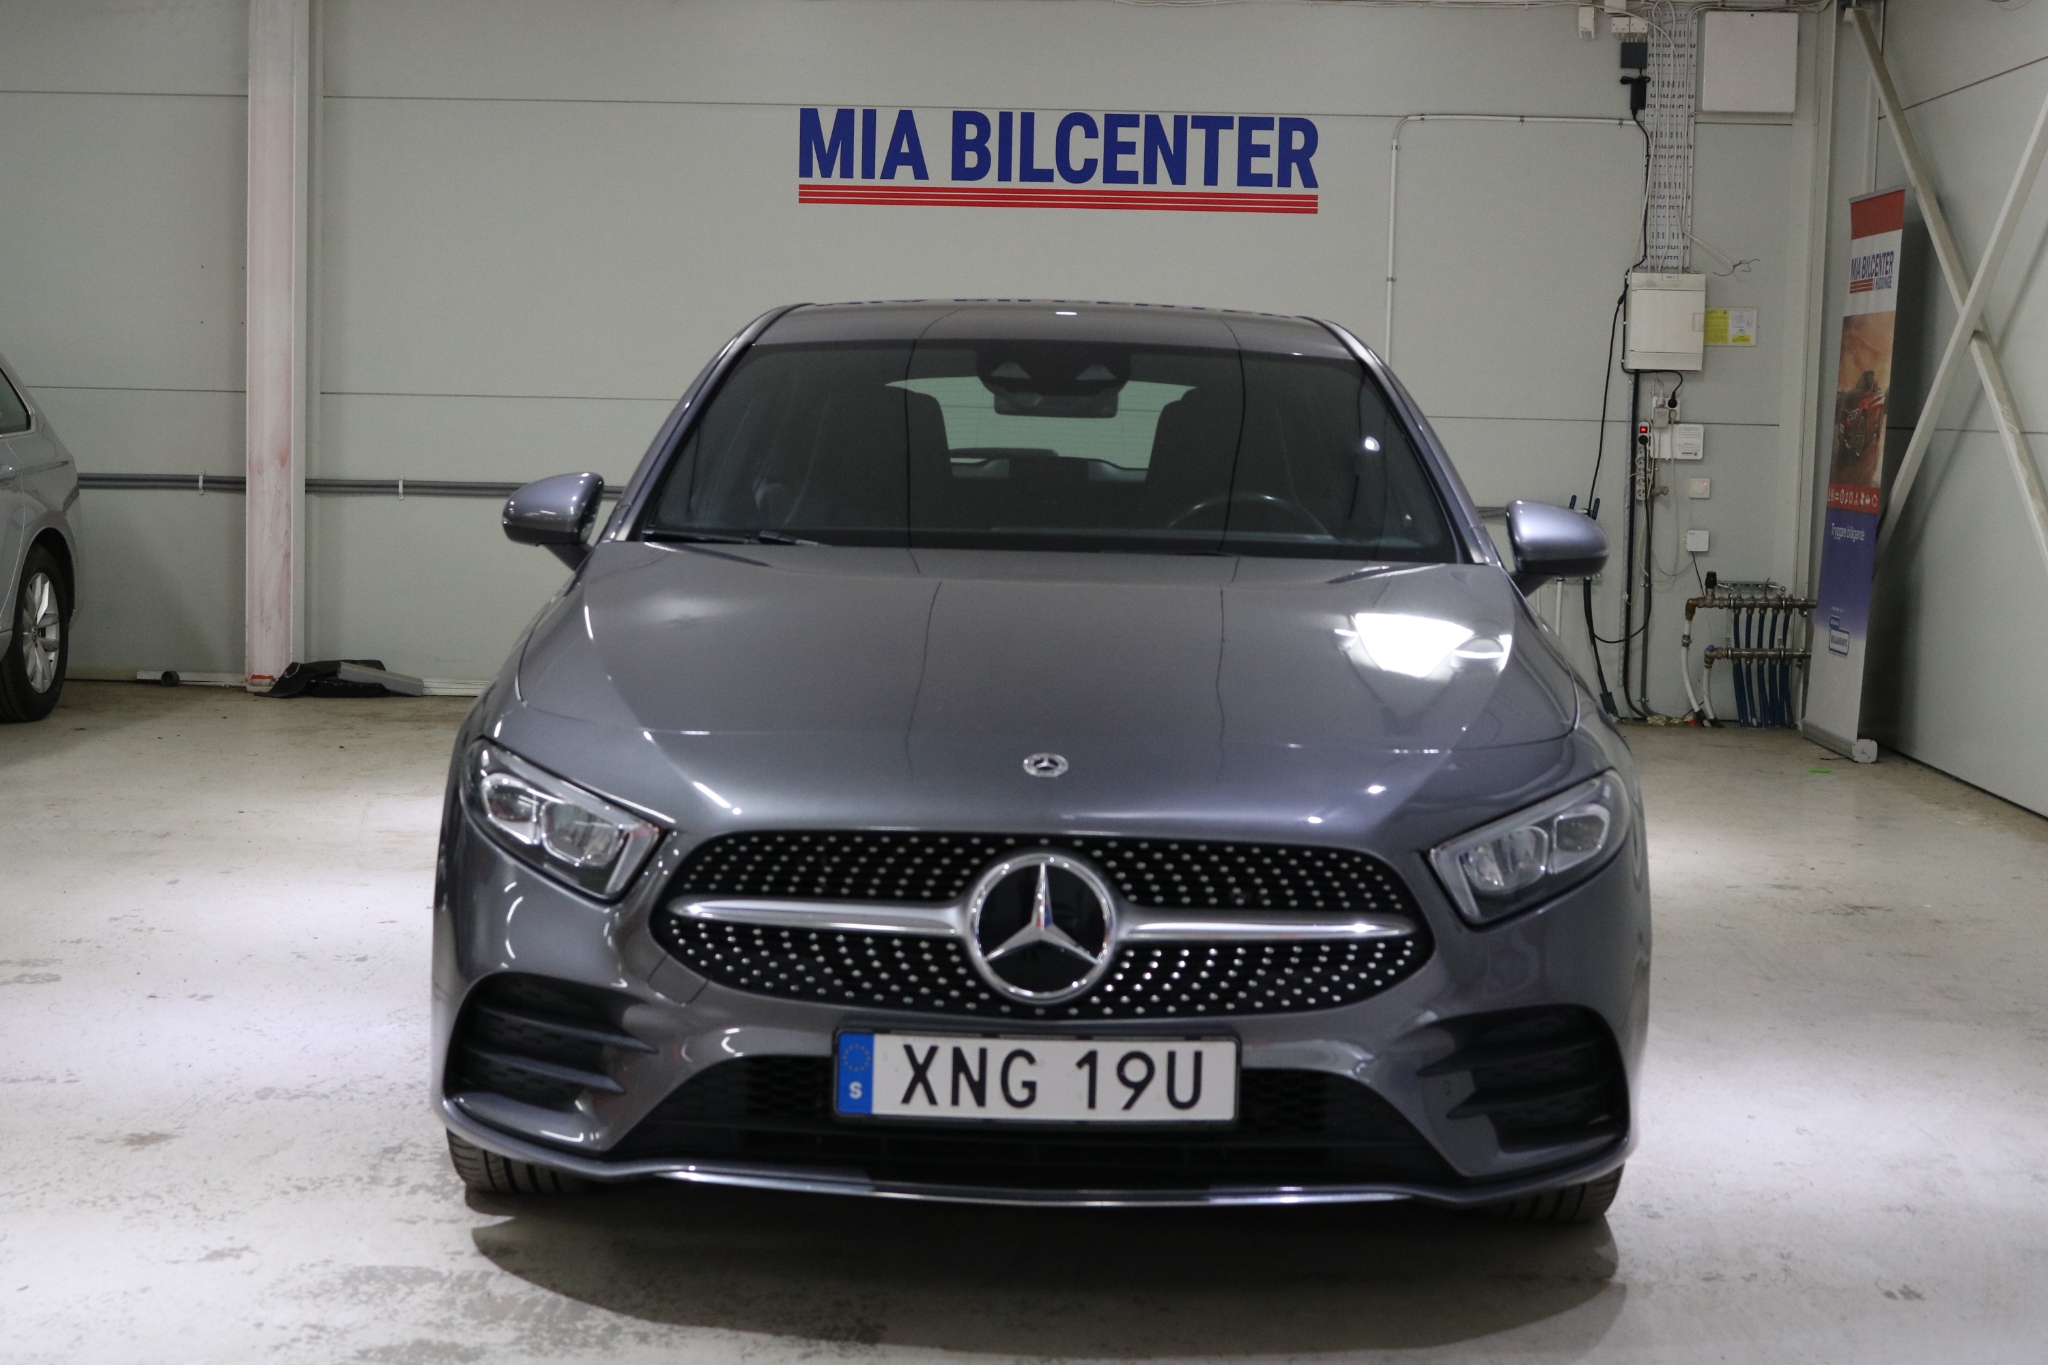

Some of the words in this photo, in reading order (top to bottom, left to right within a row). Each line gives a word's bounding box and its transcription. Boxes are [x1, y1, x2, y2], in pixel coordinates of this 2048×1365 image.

[800, 107, 929, 180] MIA
[951, 110, 1318, 188] BILCENTER
[1851, 258, 1861, 280] MIA
[1861, 251, 1894, 279] BILCENTER
[848, 1081, 863, 1099] S
[901, 1044, 1037, 1109] XNG
[1075, 1050, 1203, 1111] 19U
